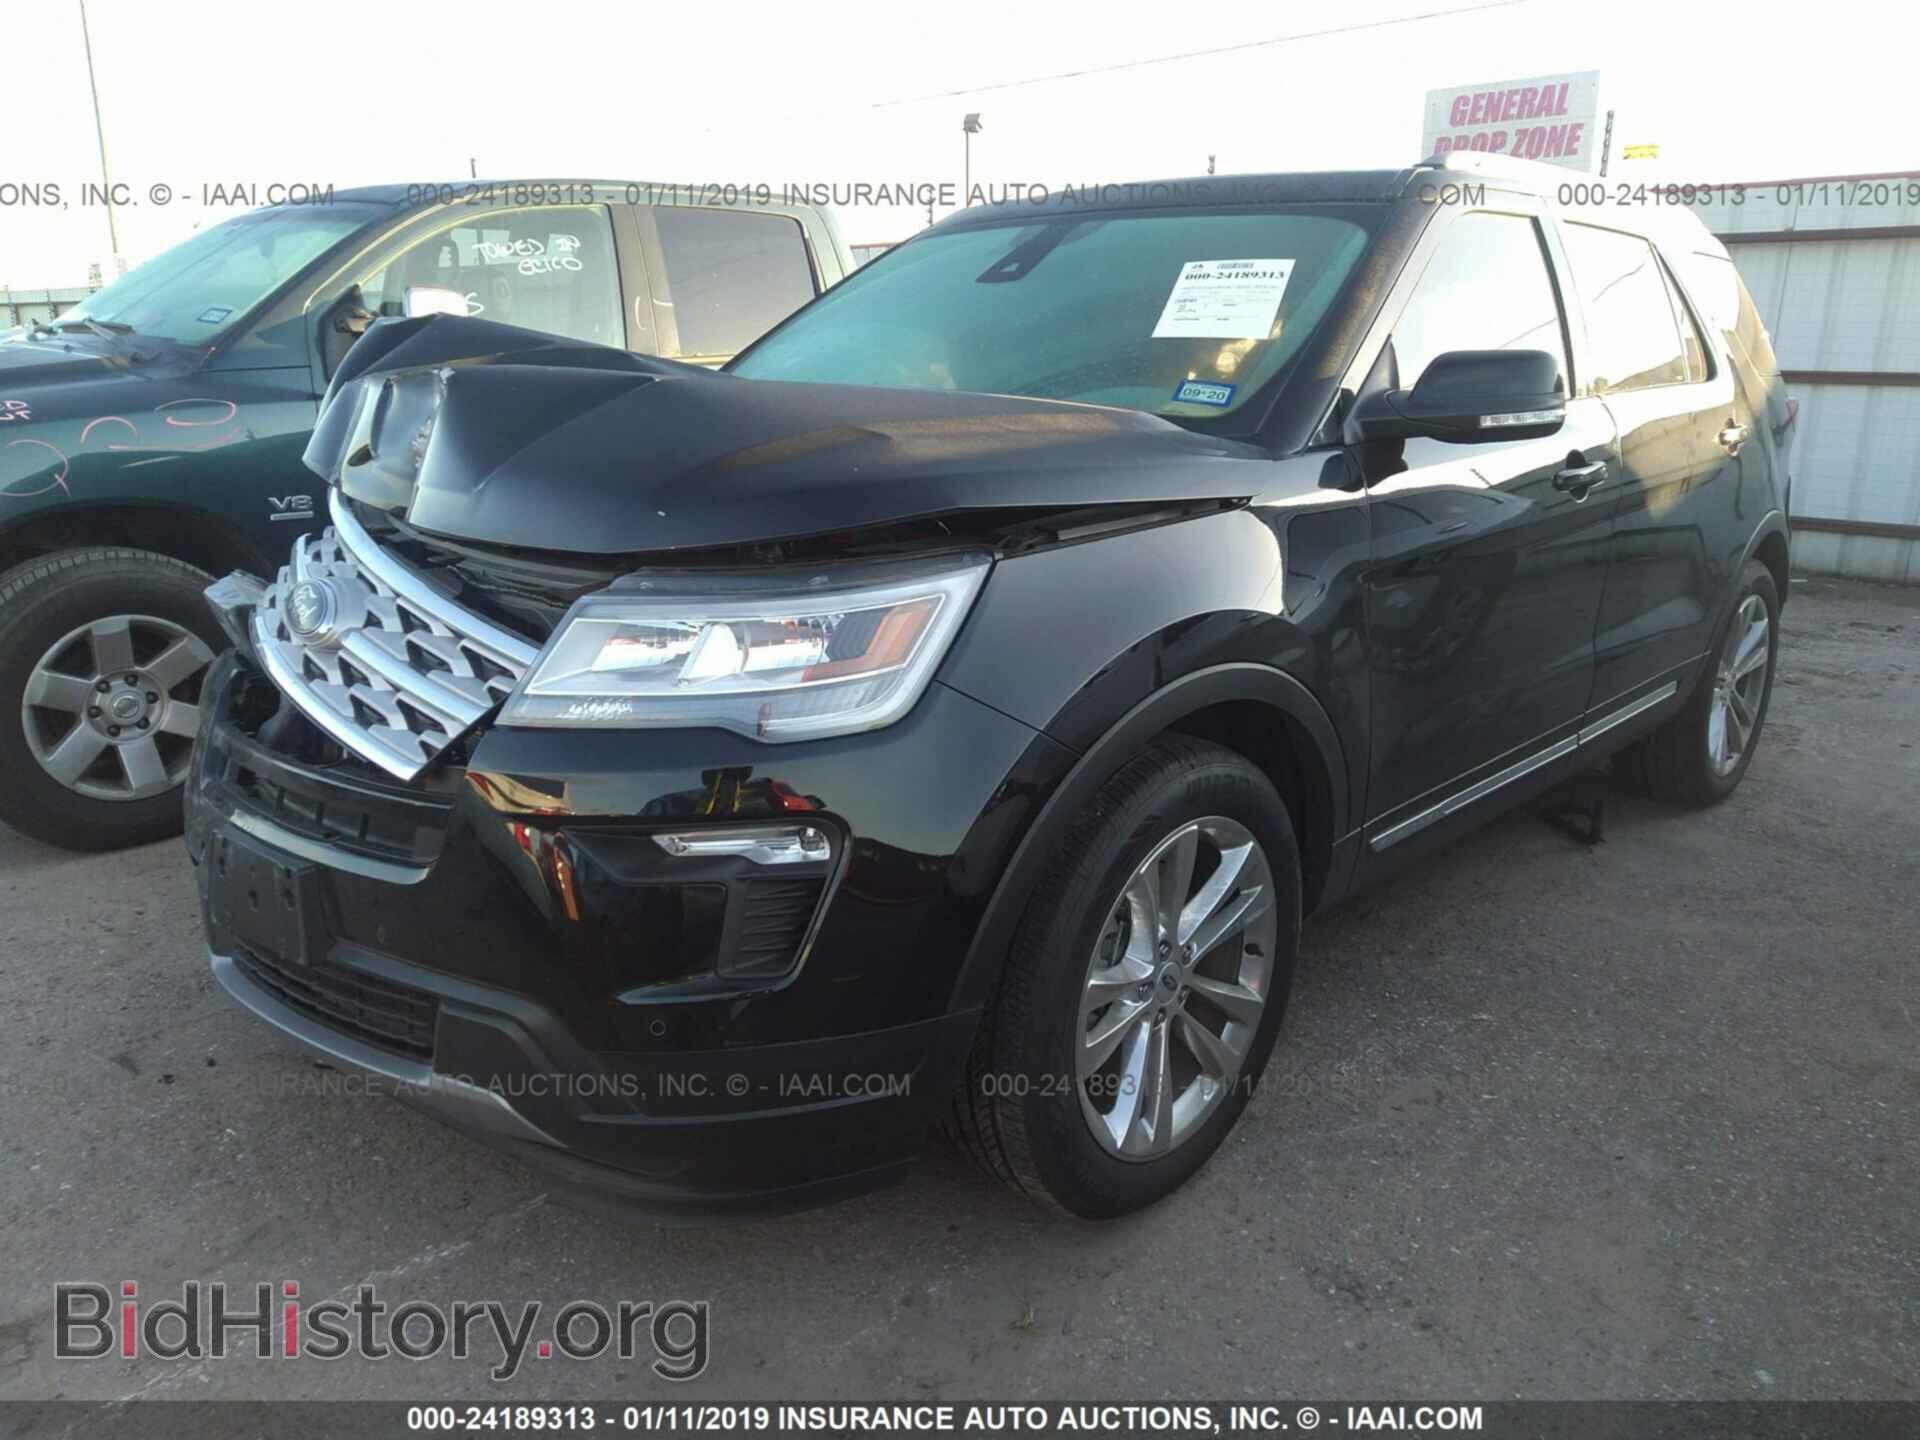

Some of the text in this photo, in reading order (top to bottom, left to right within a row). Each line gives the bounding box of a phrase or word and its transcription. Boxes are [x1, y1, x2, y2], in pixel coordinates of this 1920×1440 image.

[1450, 83, 1569, 128] GENERAL
[1510, 123, 1584, 160] ZONE
[472, 238, 545, 264] TOWED
[1184, 271, 1285, 280] 000-24189313
[268, 495, 313, 512] V8
